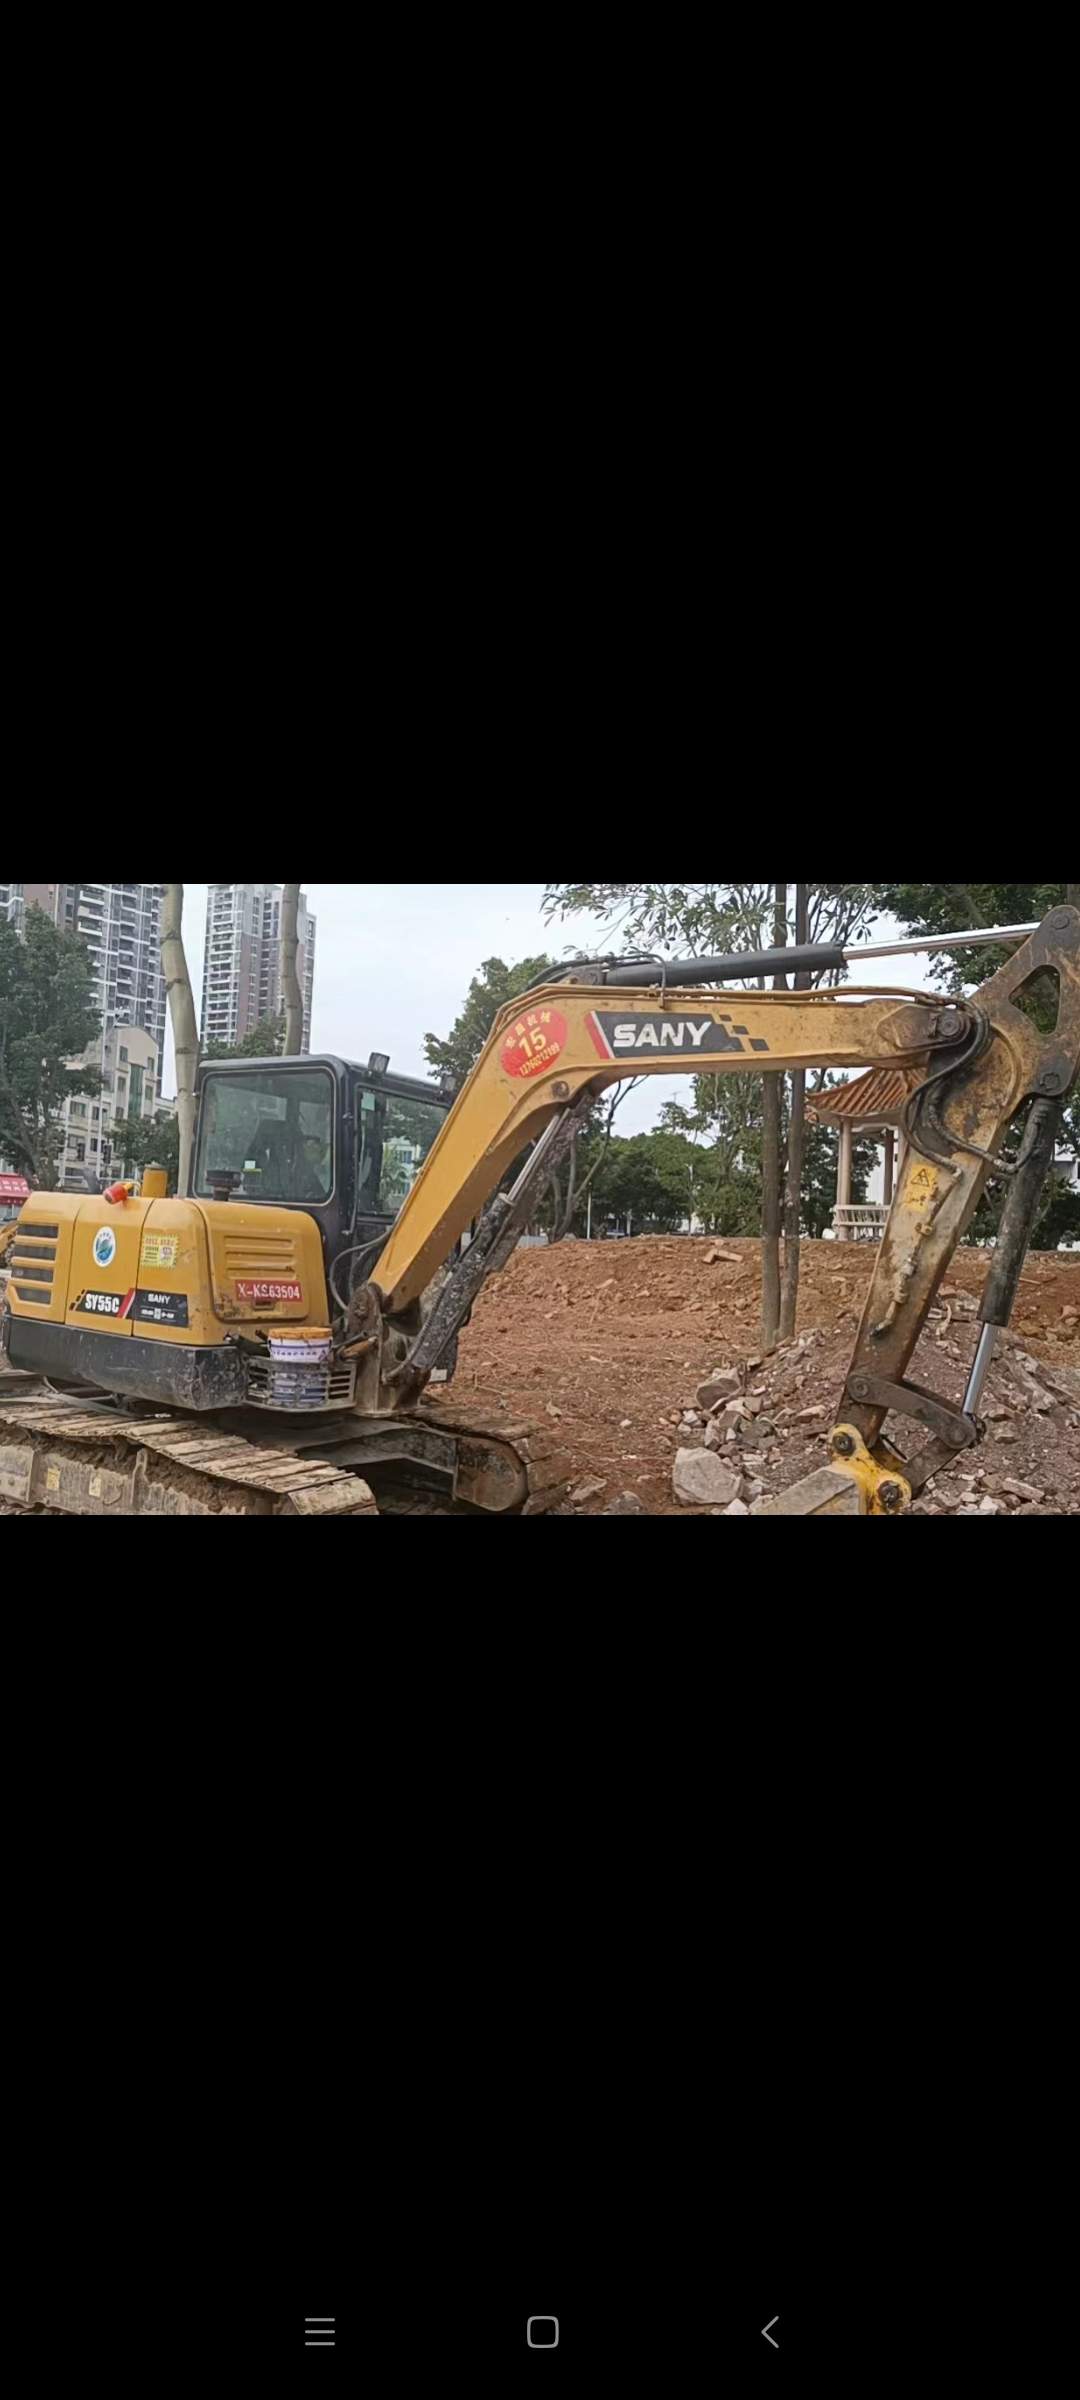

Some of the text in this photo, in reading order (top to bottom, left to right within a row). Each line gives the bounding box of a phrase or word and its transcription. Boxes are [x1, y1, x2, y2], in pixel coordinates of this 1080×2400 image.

[519, 1026, 547, 1058] 15
[613, 1021, 712, 1048] SANY
[147, 1293, 171, 1305] SANY
[238, 1283, 300, 1299] X-KS63504
[84, 1293, 120, 1314] SY55C
